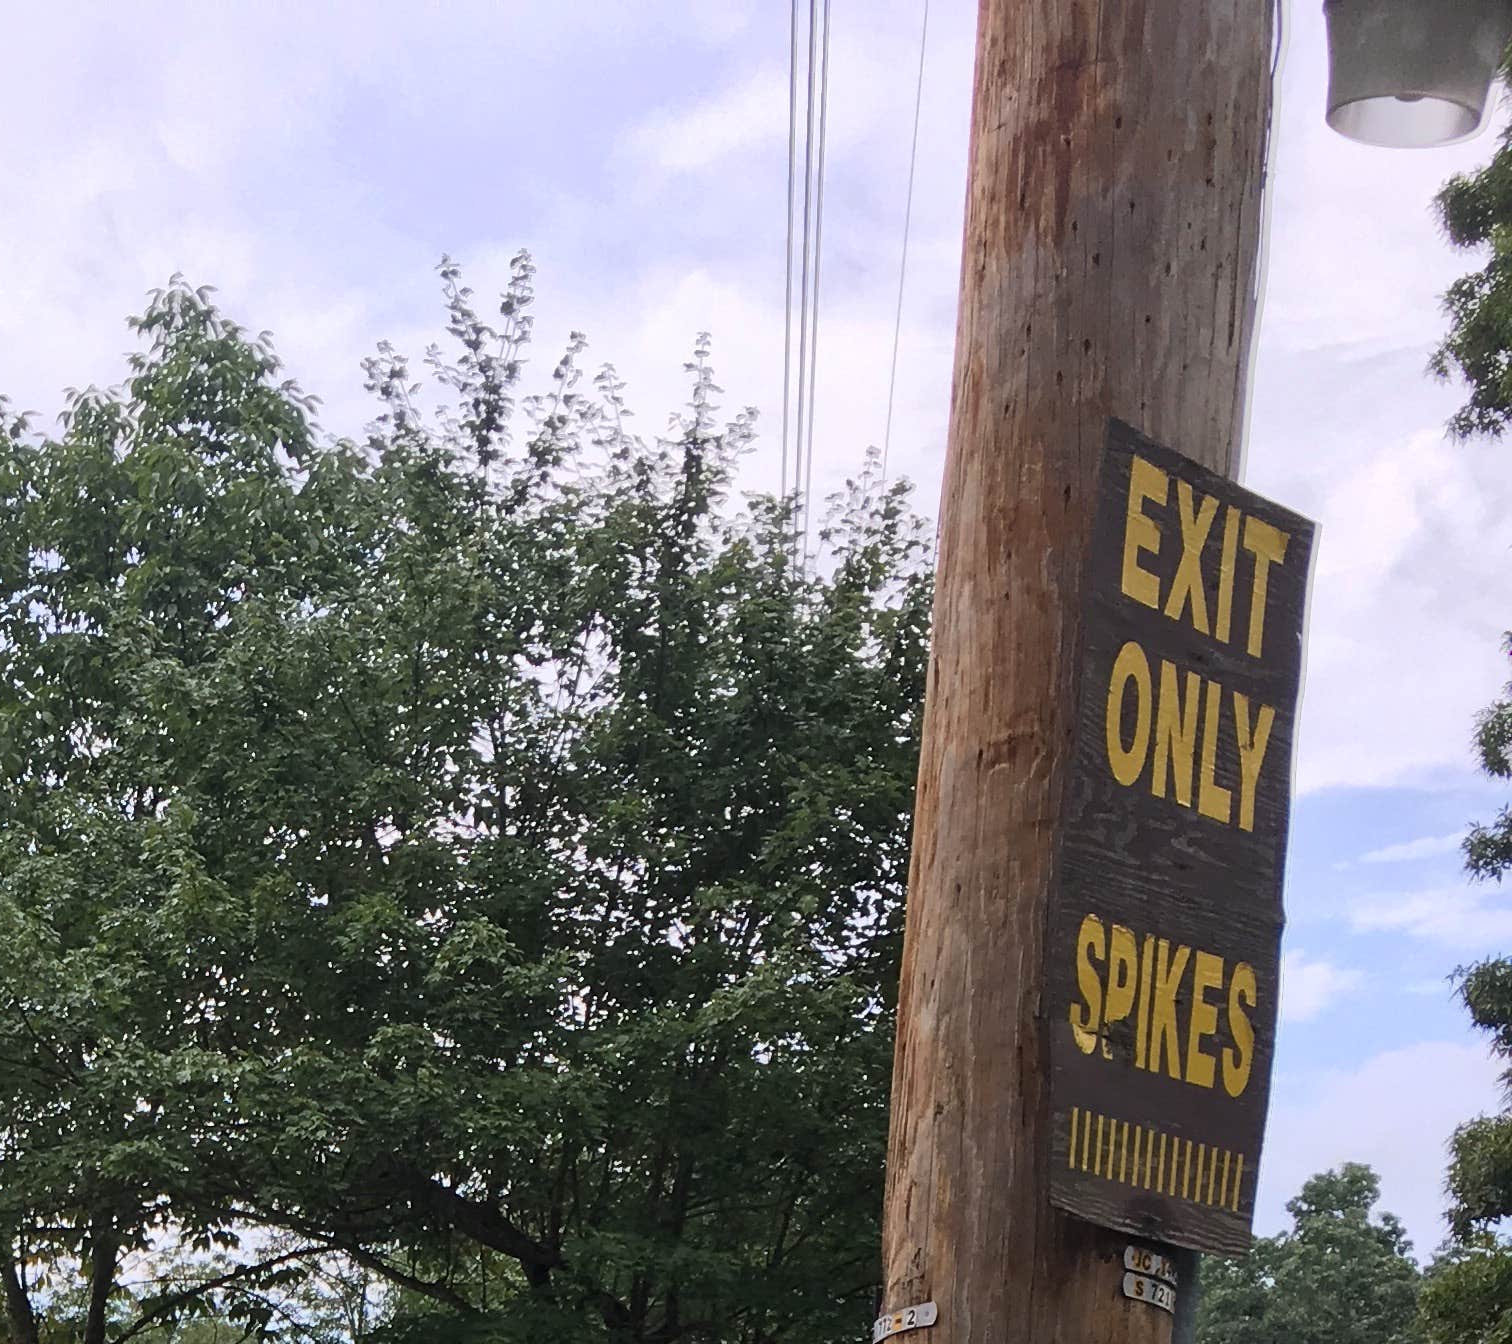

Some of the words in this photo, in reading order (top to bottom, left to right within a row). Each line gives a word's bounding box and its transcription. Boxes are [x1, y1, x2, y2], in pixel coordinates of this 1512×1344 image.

[1120, 453, 1288, 660] EXIT
[1105, 640, 1278, 833] ONLY
[1070, 912, 1259, 1099] SPIKES
